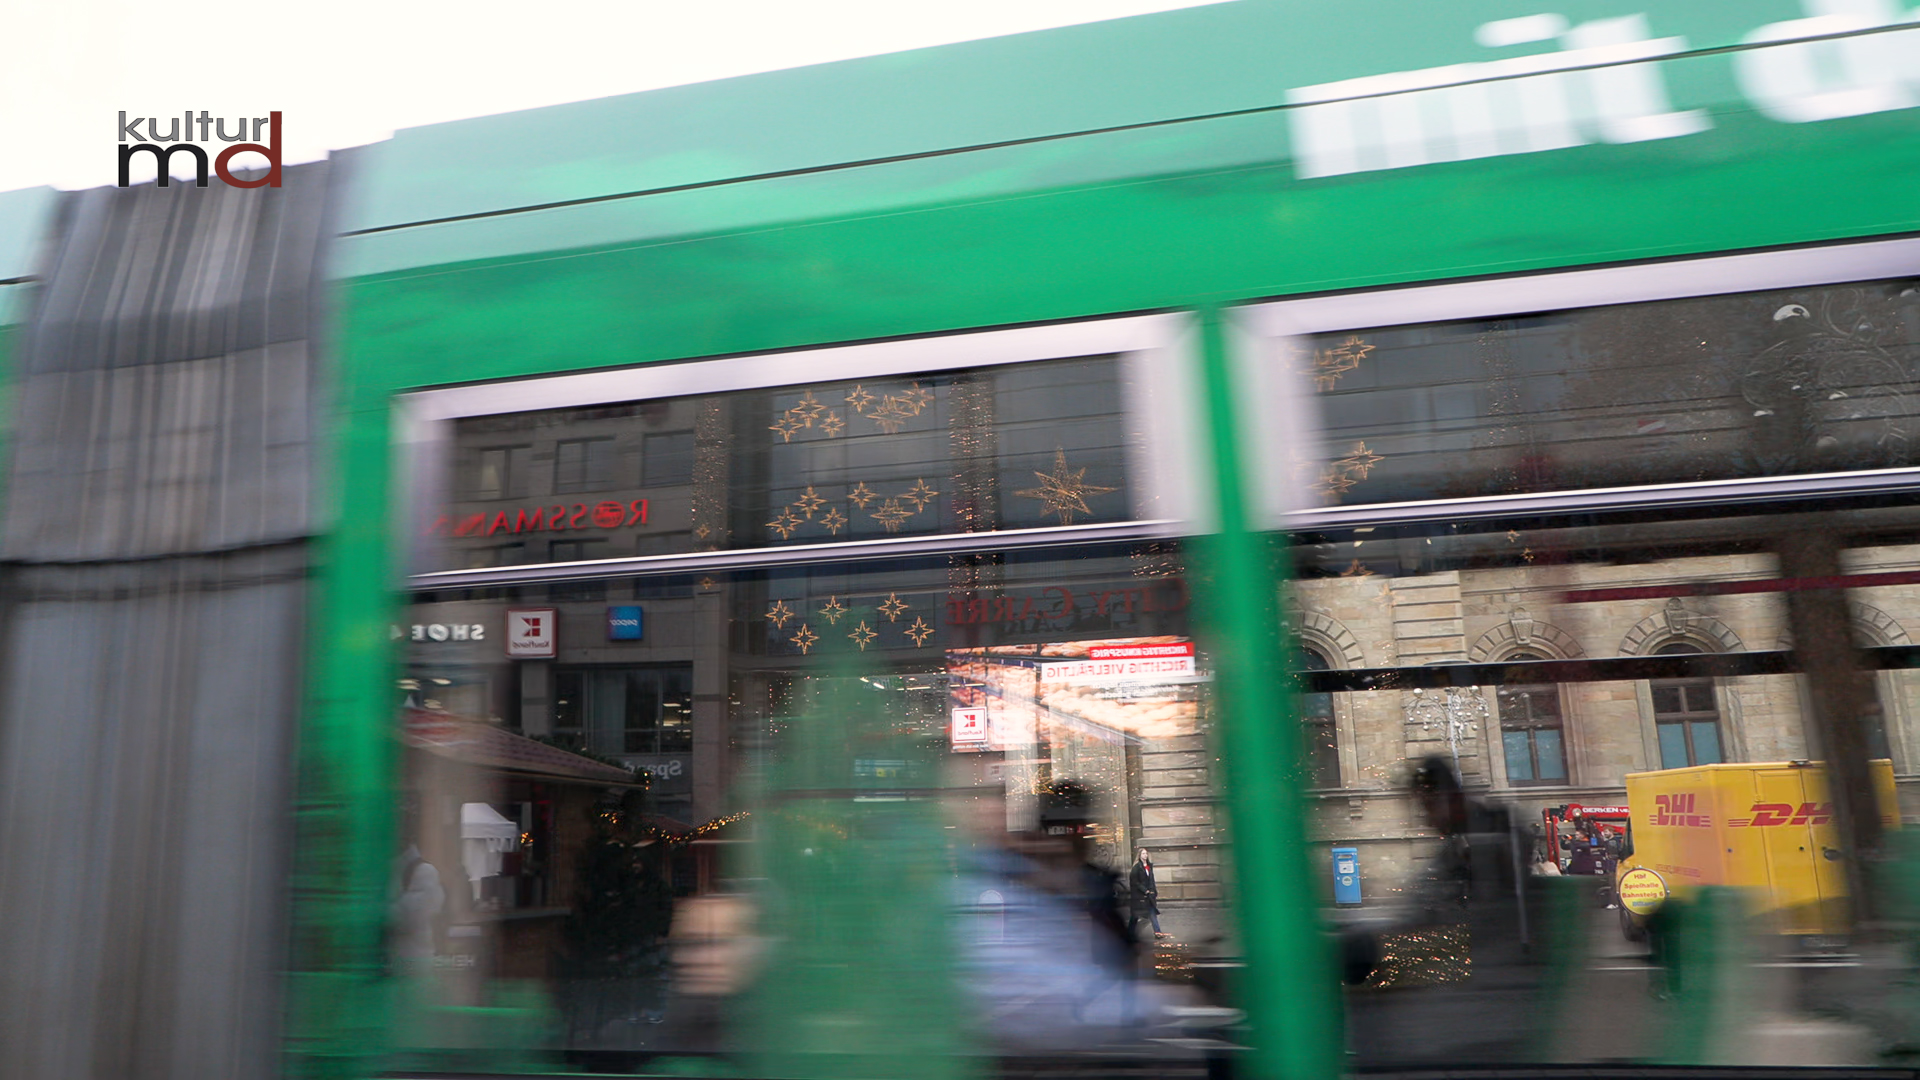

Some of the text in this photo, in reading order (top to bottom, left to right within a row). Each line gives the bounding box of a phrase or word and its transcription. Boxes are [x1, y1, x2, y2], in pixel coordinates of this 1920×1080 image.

[1285, 12, 1714, 179] mit
[1656, 793, 1701, 827] DHL
[1750, 802, 1835, 826] DH
[1622, 891, 1658, 899] Bahnsteig
[1624, 882, 1659, 890] Spielhalle
